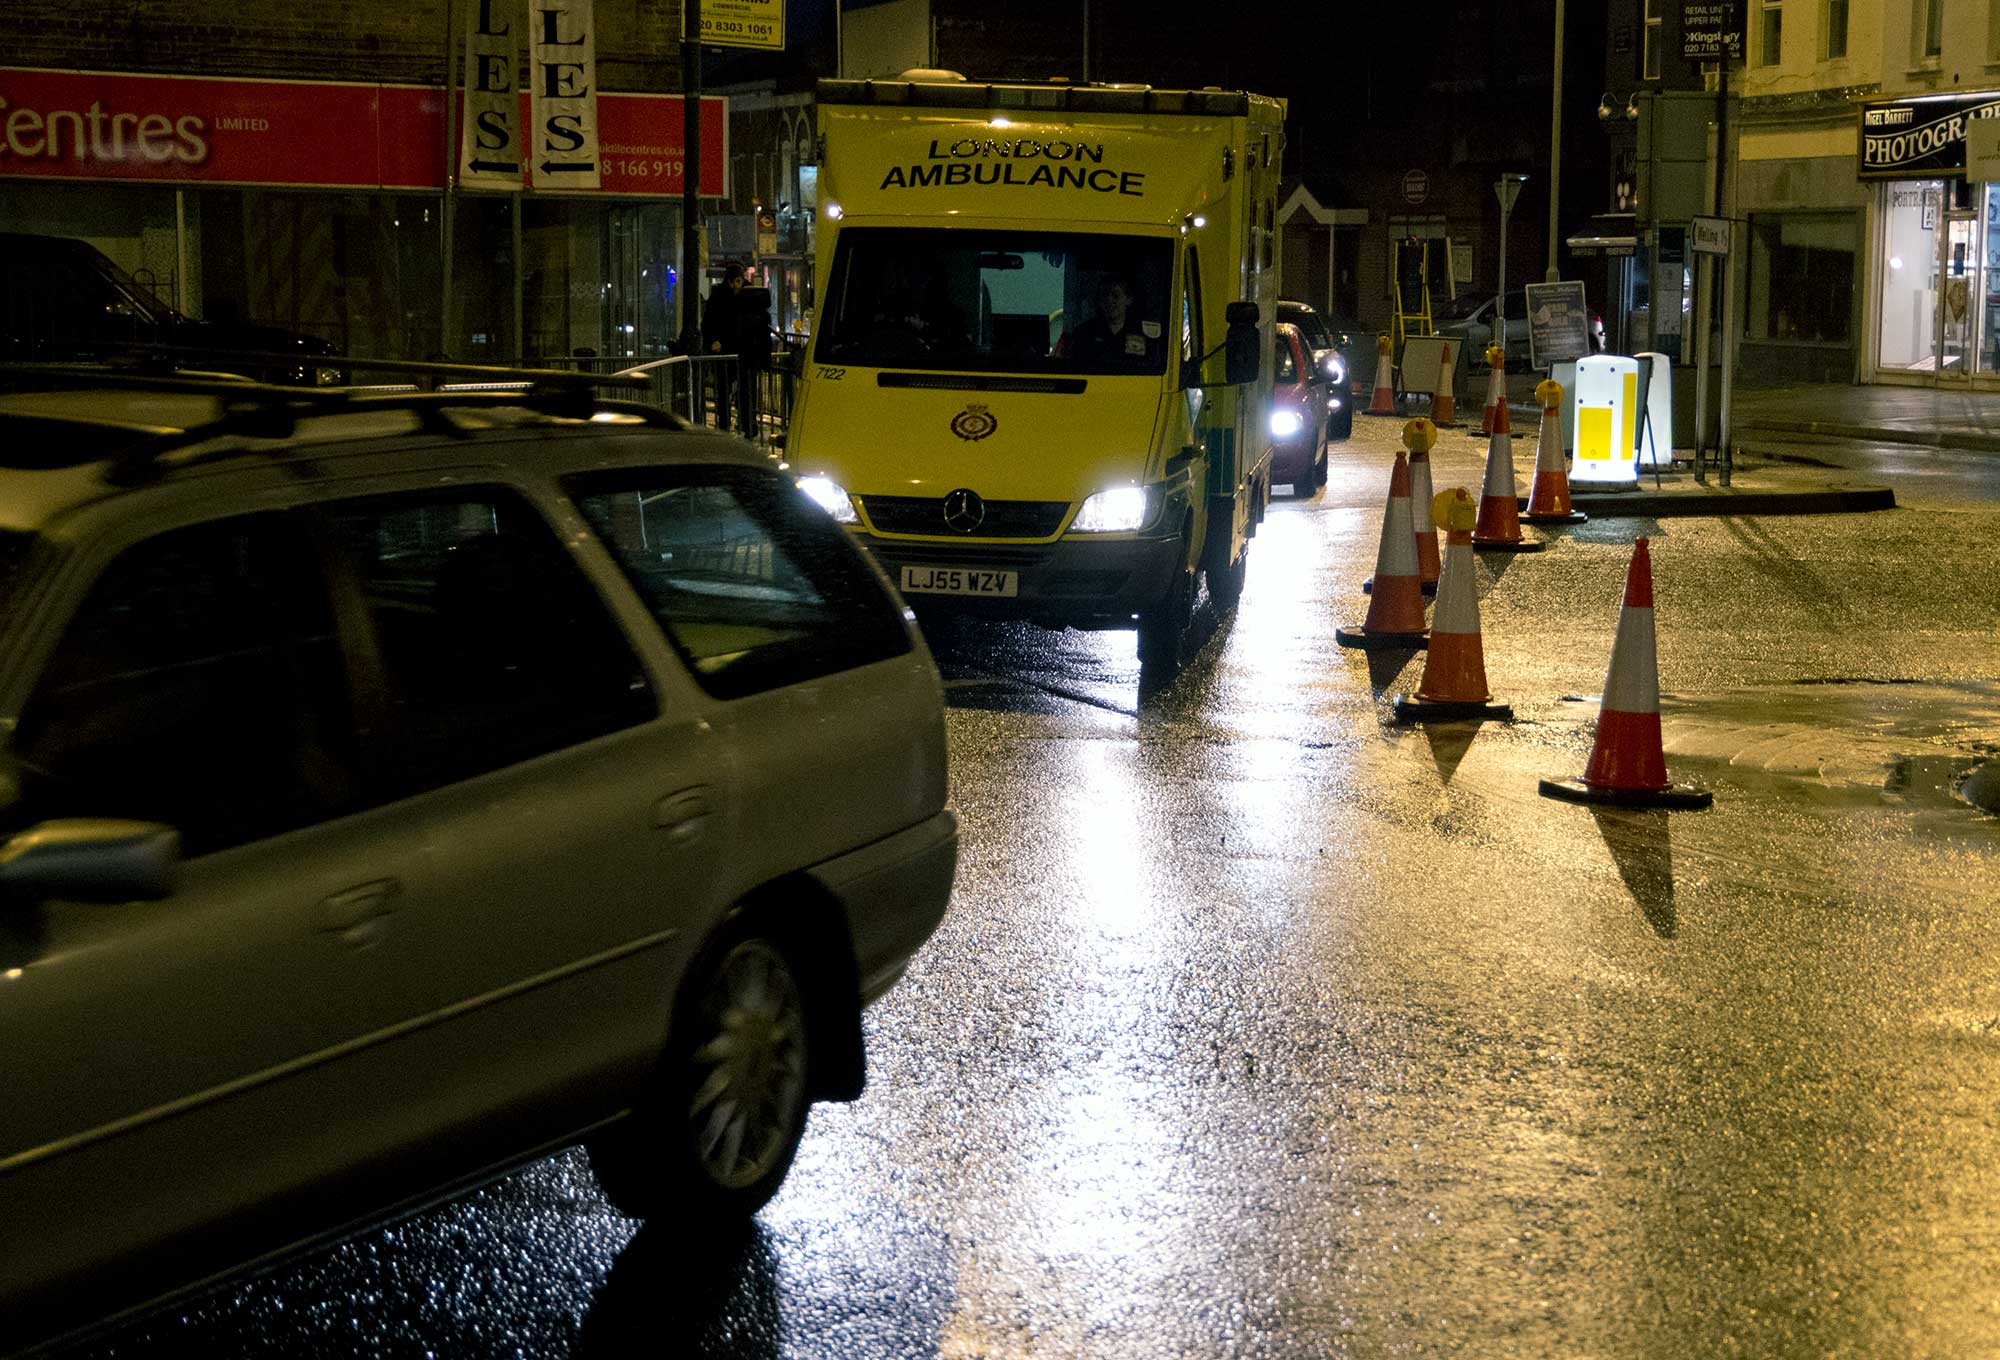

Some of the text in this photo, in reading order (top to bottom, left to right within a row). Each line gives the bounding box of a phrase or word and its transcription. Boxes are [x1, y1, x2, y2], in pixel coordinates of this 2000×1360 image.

[1684, 6, 1708, 15] RETAIL
[715, 21, 743, 32] 8303
[747, 24, 773, 35] 1061
[1684, 16, 1708, 25] UPPER
[1684, 44, 1699, 53] 020
[215, 116, 271, 132] LIMITED
[1865, 109, 1914, 126] NIGEL BARRETT
[0, 97, 210, 165] entres
[928, 138, 1105, 163] LONDON
[617, 159, 648, 177] 166
[652, 159, 684, 177] 919
[880, 163, 1146, 196] AMBULANCE
[815, 367, 847, 380] 7122
[908, 569, 1007, 593] LJ55 WZV
